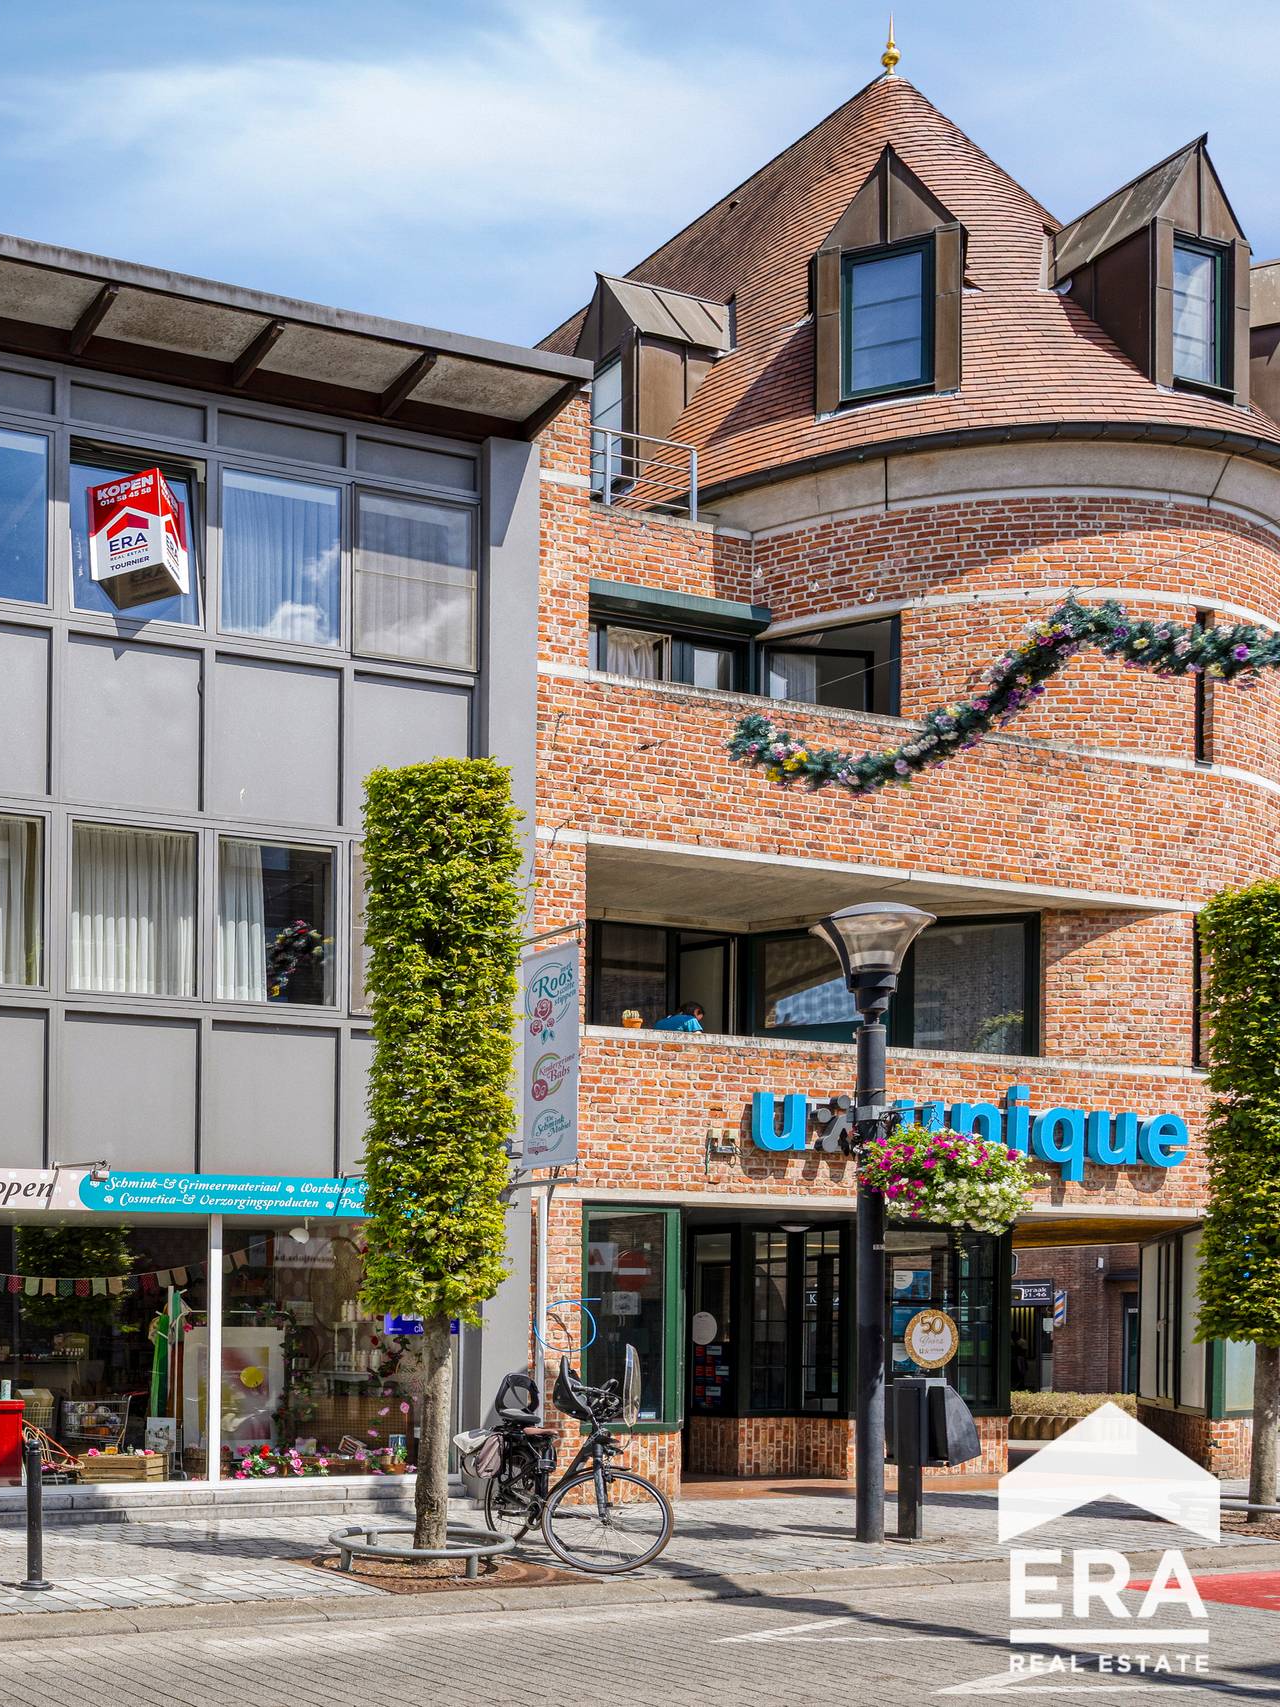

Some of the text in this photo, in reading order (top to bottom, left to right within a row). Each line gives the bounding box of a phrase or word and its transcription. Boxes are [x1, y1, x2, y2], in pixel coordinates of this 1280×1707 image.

[97, 475, 153, 500] KOPEN
[100, 498, 115, 507] 014
[109, 532, 147, 552] ERA
[110, 547, 148, 561] REAL ESTATE
[110, 555, 149, 571] TOURNIER
[532, 967, 573, 998] Roos
[554, 989, 576, 1006] stippen
[539, 1053, 575, 1076] Kindergrime
[547, 1065, 570, 1081] Babs
[536, 1113, 565, 1137] Schmink
[178, 1178, 282, 1194] Grimeermateriaal
[300, 1182, 356, 1197] Workshops
[200, 1194, 319, 1210] Verzorgingsproducten
[920, 1315, 945, 1335] 50
